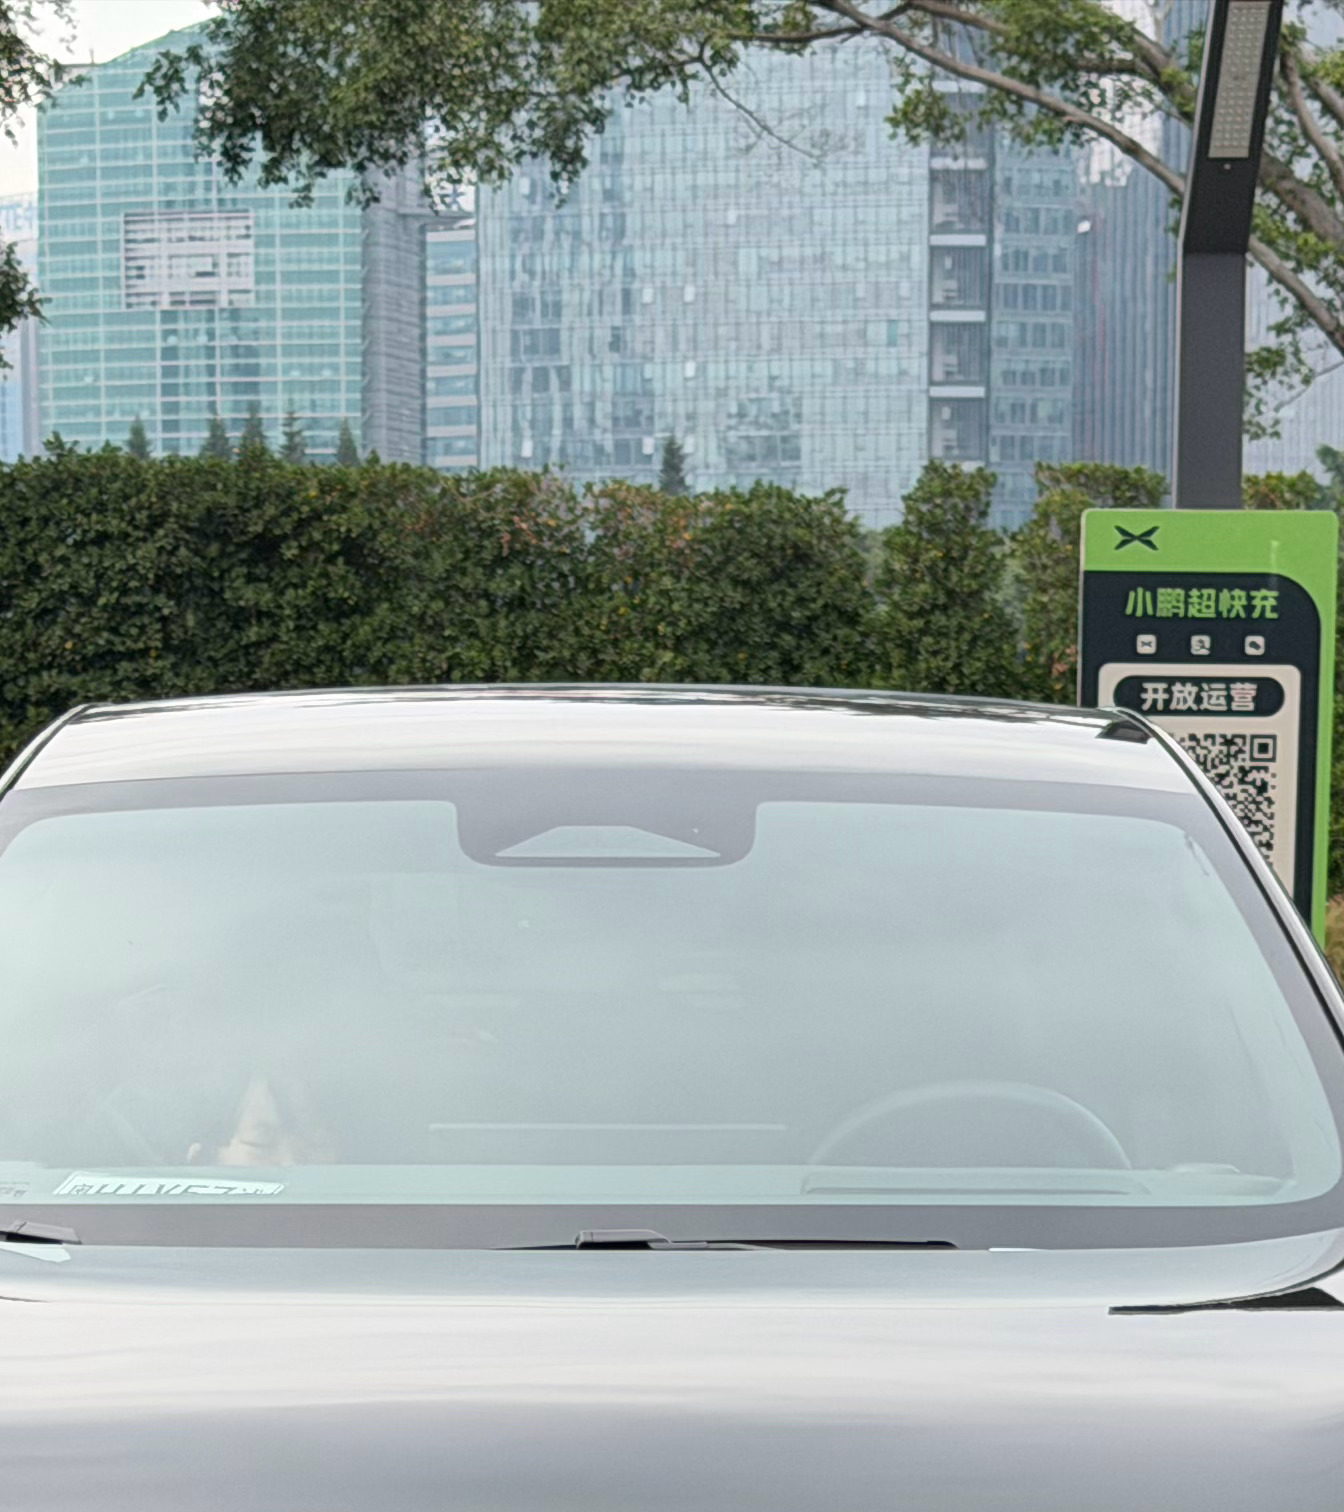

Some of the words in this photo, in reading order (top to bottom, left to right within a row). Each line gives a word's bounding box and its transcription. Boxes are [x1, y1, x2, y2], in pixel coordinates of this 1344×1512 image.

[1125, 587, 1280, 620] 小鹏超快充
[1140, 682, 1258, 712] 开放运营
